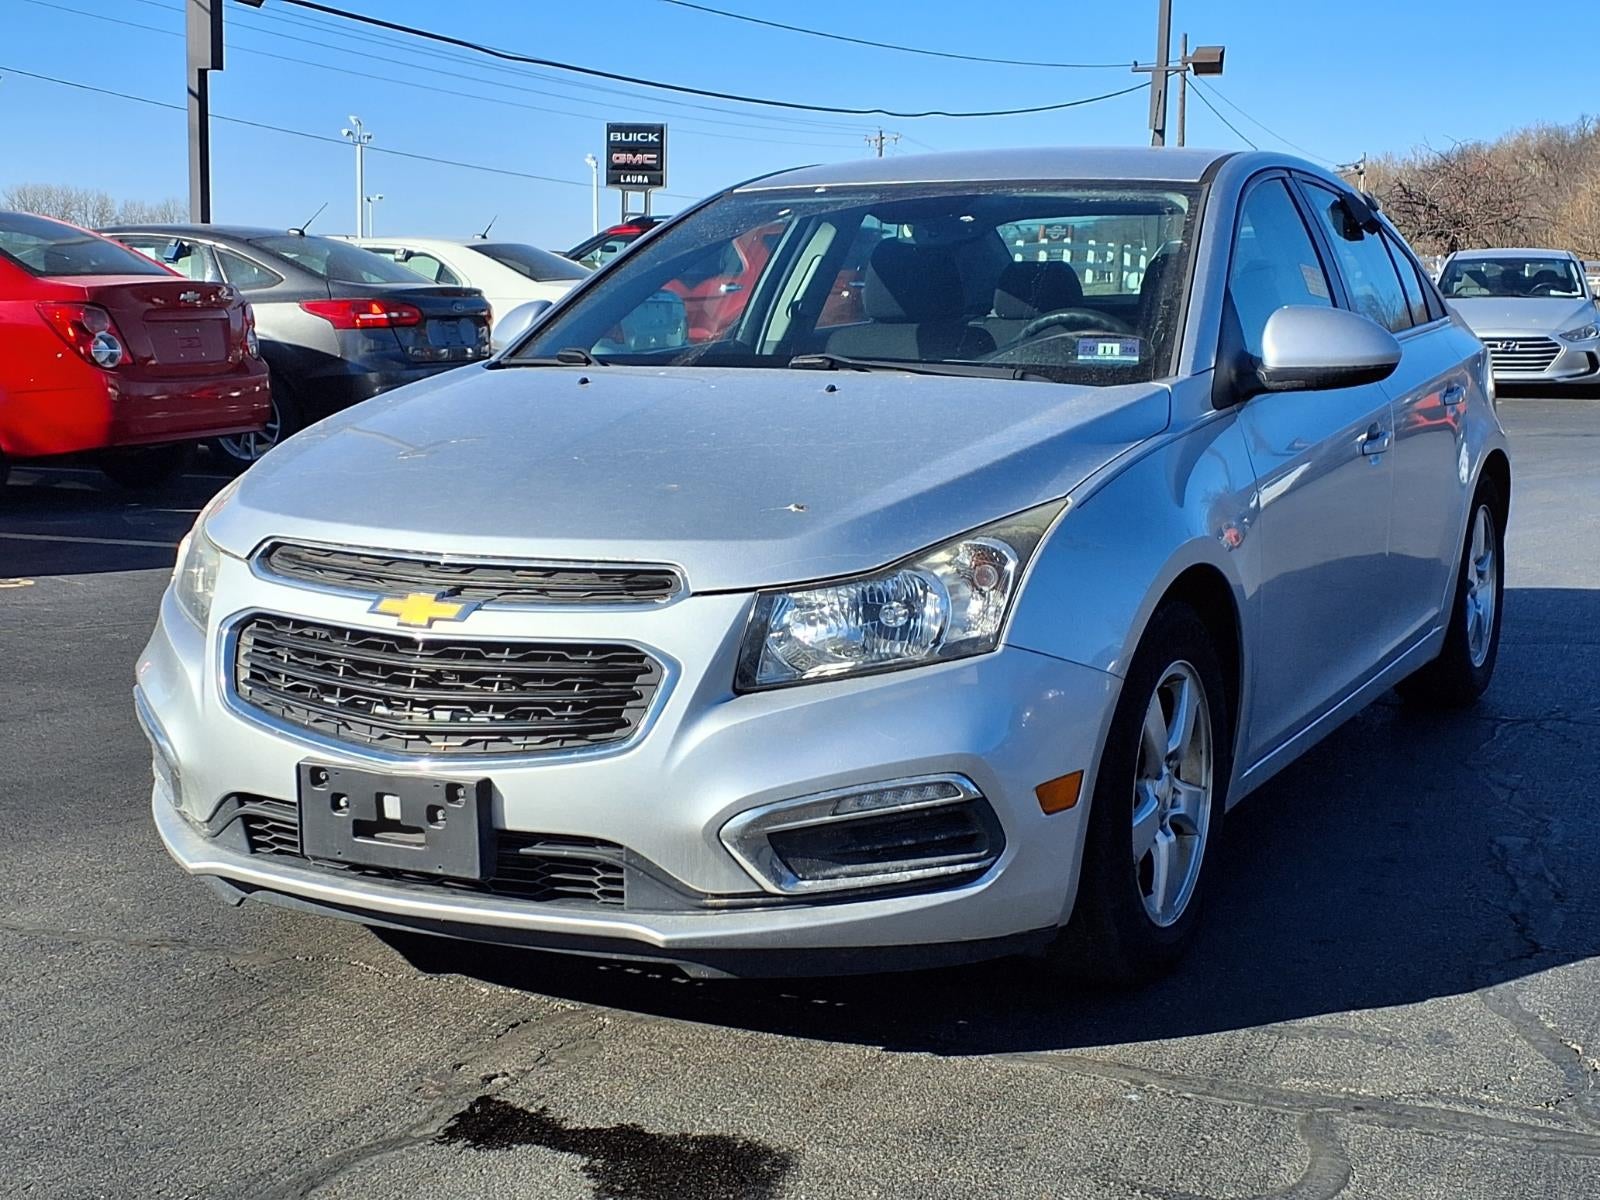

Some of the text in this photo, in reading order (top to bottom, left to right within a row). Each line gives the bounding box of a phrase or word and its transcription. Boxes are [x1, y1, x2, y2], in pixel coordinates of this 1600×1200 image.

[610, 132, 660, 142] BUICK
[612, 153, 657, 164] GMC
[620, 174, 649, 183] LAURA
[1102, 345, 1114, 354] 11
